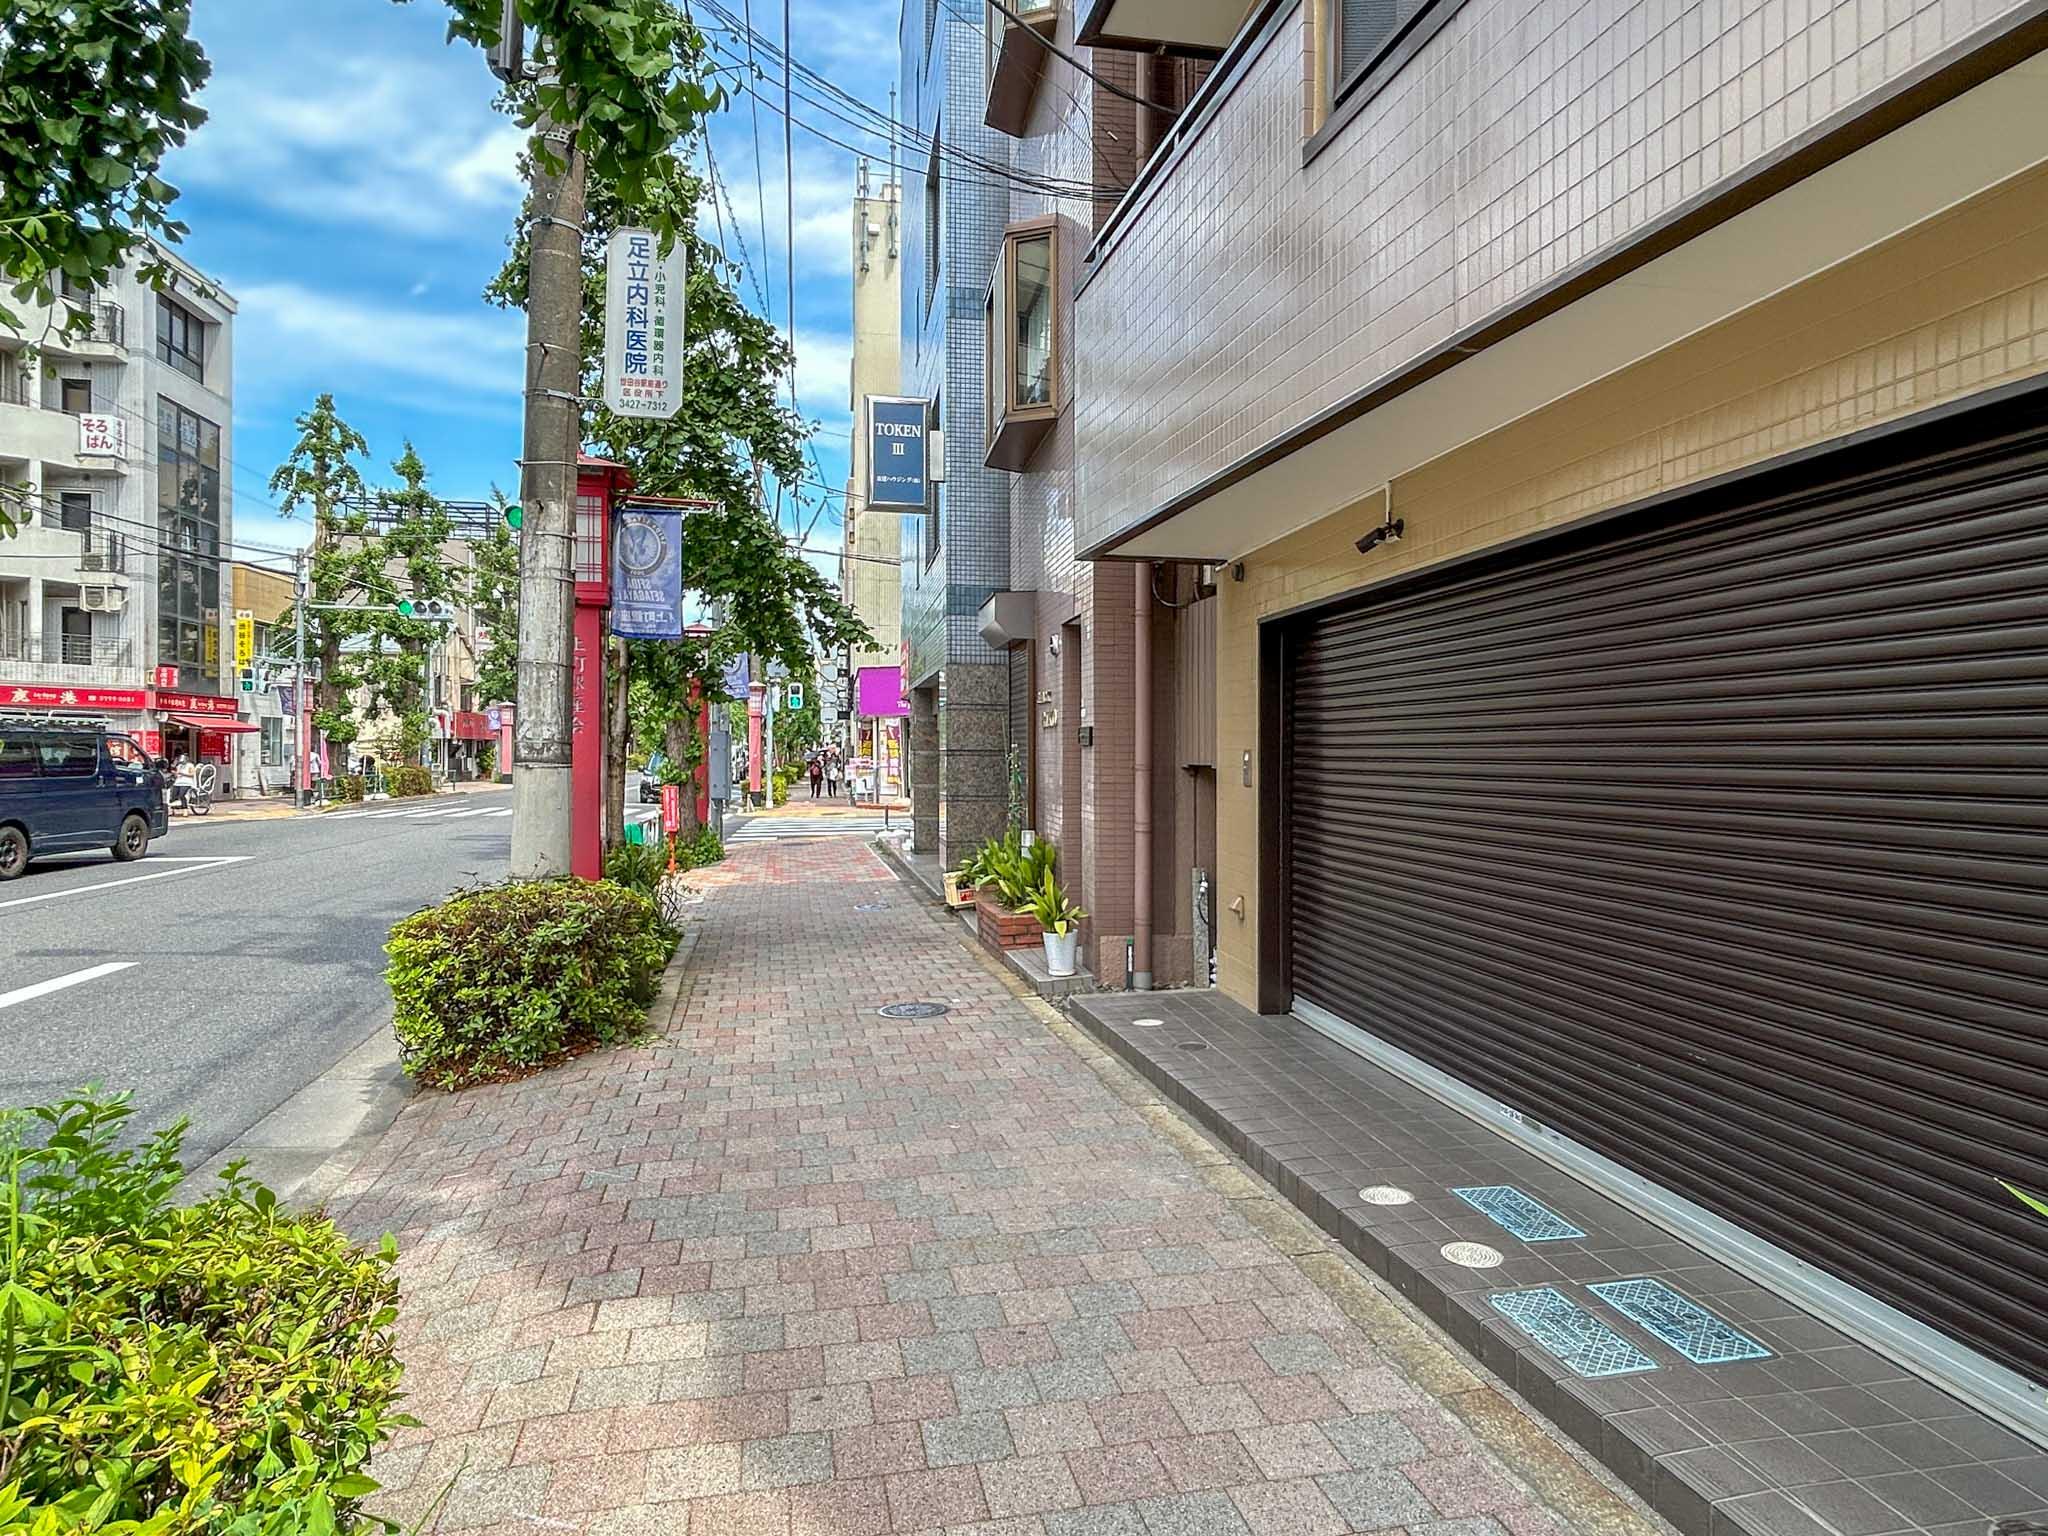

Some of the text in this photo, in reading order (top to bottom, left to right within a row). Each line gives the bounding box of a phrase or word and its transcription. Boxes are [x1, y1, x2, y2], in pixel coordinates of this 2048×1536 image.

[624, 236, 651, 375] 足立内科医院
[652, 250, 667, 377] ・小児科・循環器内科
[622, 388, 665, 400] 区役所下
[619, 398, 668, 411] 3427-7312
[82, 418, 108, 433] そろ
[875, 422, 922, 438] TOKEN
